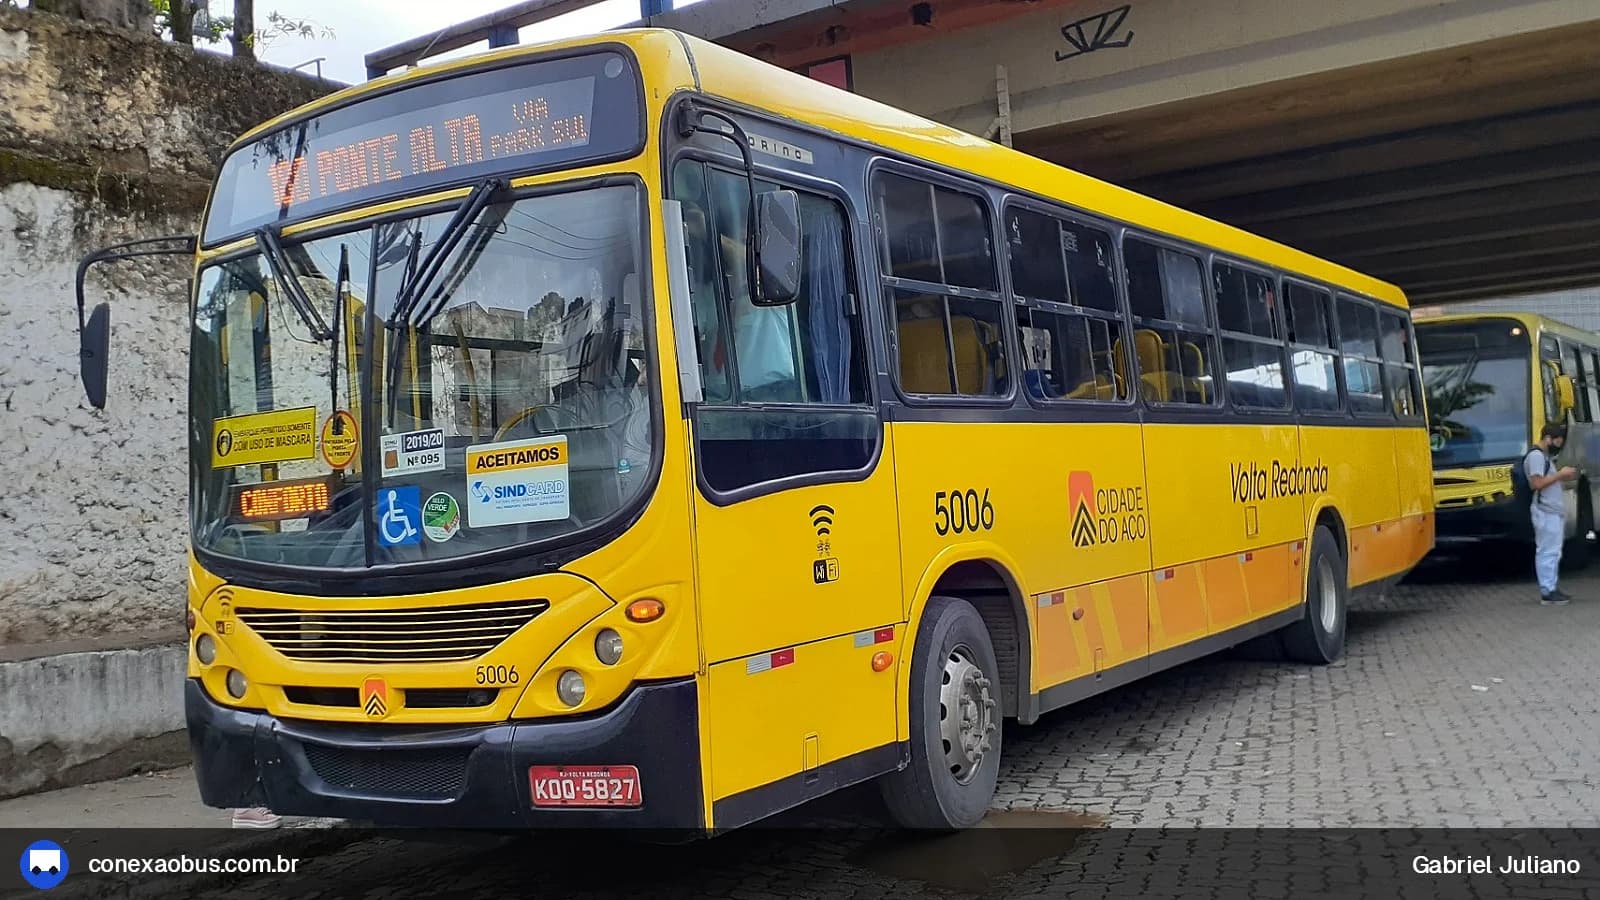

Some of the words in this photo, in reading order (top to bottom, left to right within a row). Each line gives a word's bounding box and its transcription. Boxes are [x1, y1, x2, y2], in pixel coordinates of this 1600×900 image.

[512, 97, 549, 125] VIA
[490, 124, 546, 157] PARK
[551, 114, 588, 145] SUL
[316, 133, 401, 197] PONTE
[409, 113, 483, 175] ALTA
[747, 136, 802, 160] ORINO
[233, 441, 249, 452] COM
[249, 438, 264, 450] USO
[265, 437, 275, 448] DE
[406, 432, 443, 450] 2019/20
[407, 455, 419, 466] Nº
[420, 453, 440, 465] 095
[476, 446, 560, 470] ACEITAMOS
[494, 480, 565, 499] SINDCARD
[1230, 461, 1267, 504] Volta
[1271, 457, 1329, 498] Redonda
[427, 504, 448, 512] VERDE
[935, 488, 994, 536] 5006
[1096, 486, 1144, 515] CIDADE
[1099, 517, 1118, 544] DO
[476, 664, 519, 685] 5006
